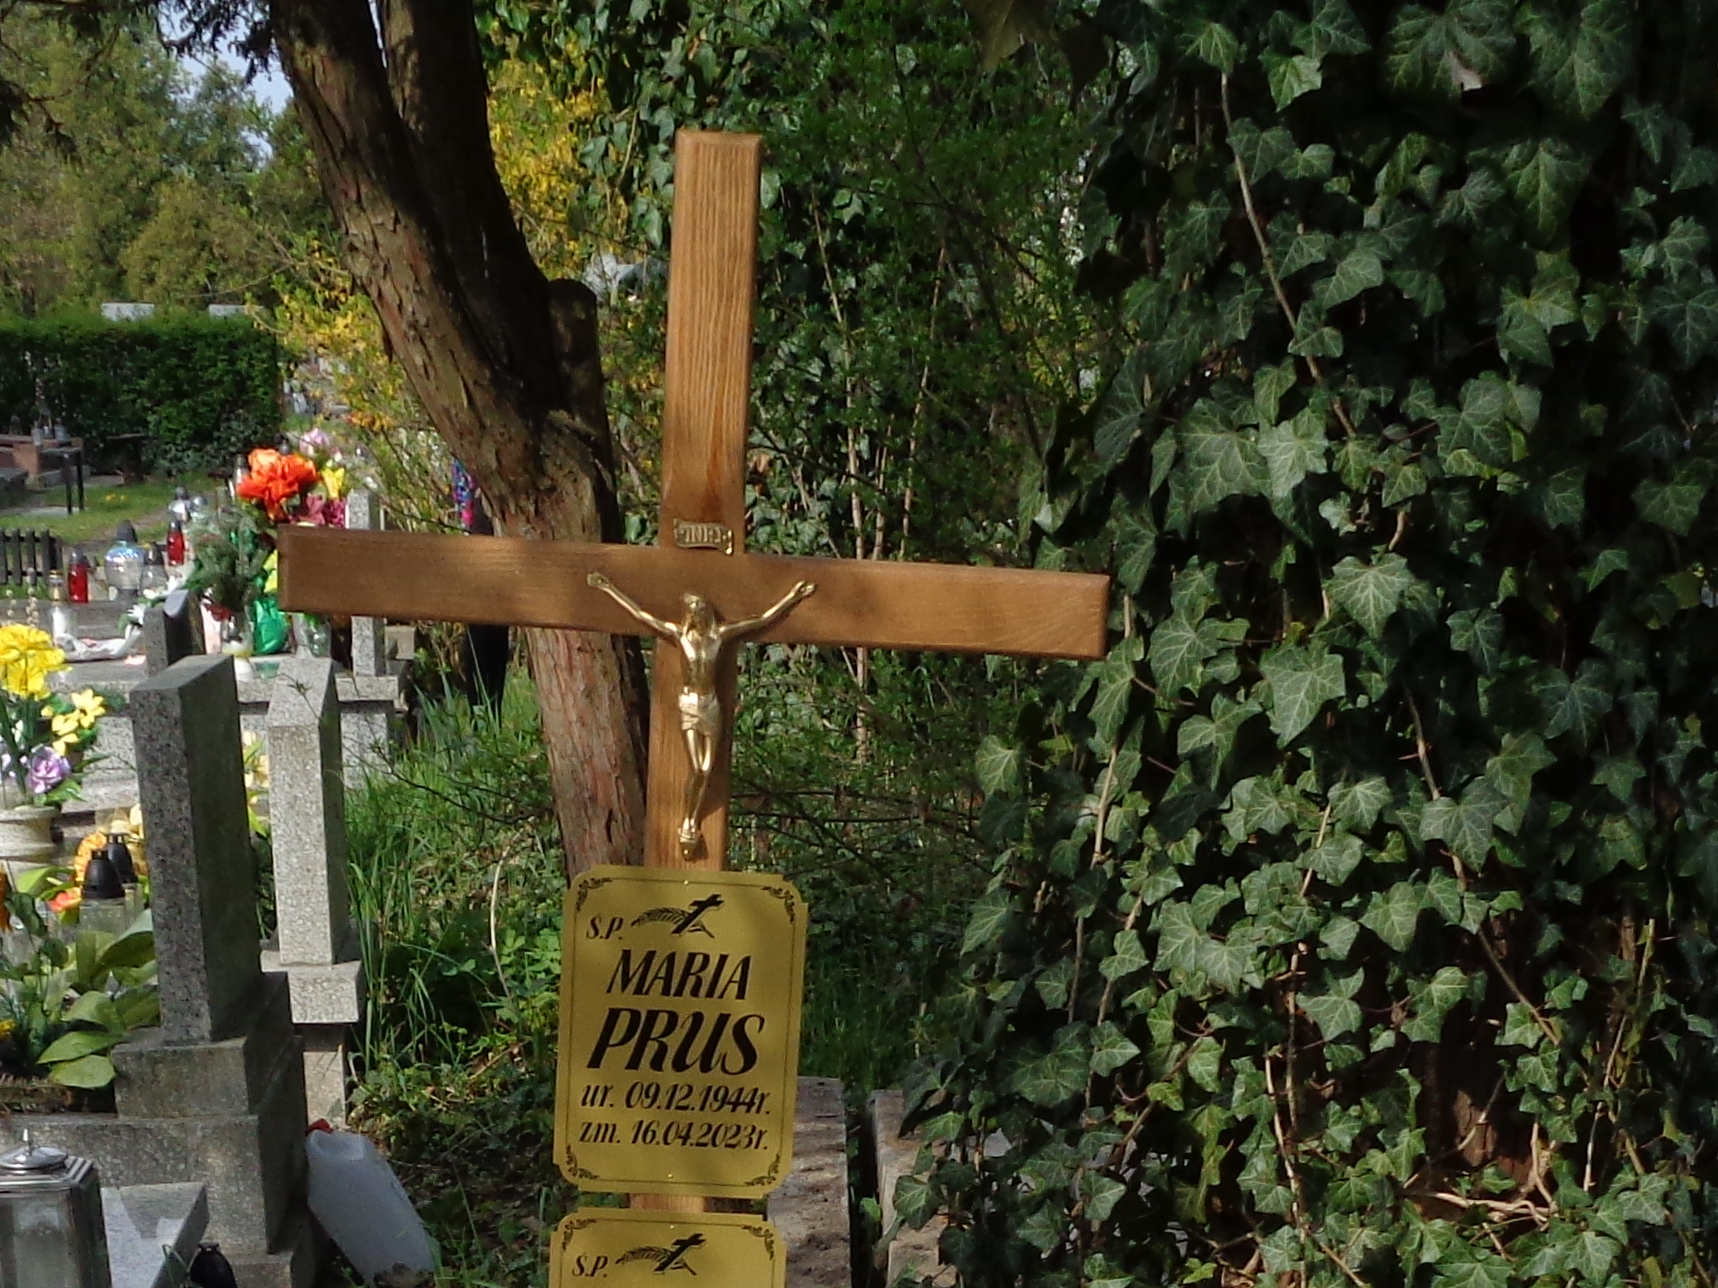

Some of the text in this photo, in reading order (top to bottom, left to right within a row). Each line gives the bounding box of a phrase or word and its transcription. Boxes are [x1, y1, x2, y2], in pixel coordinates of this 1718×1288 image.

[606, 948, 752, 1001] MARIA
[586, 1007, 766, 1076] PRUS
[581, 1080, 771, 1115] ur. 09.12.1944r.
[578, 1119, 769, 1151] zm. 16.04.2023r.
